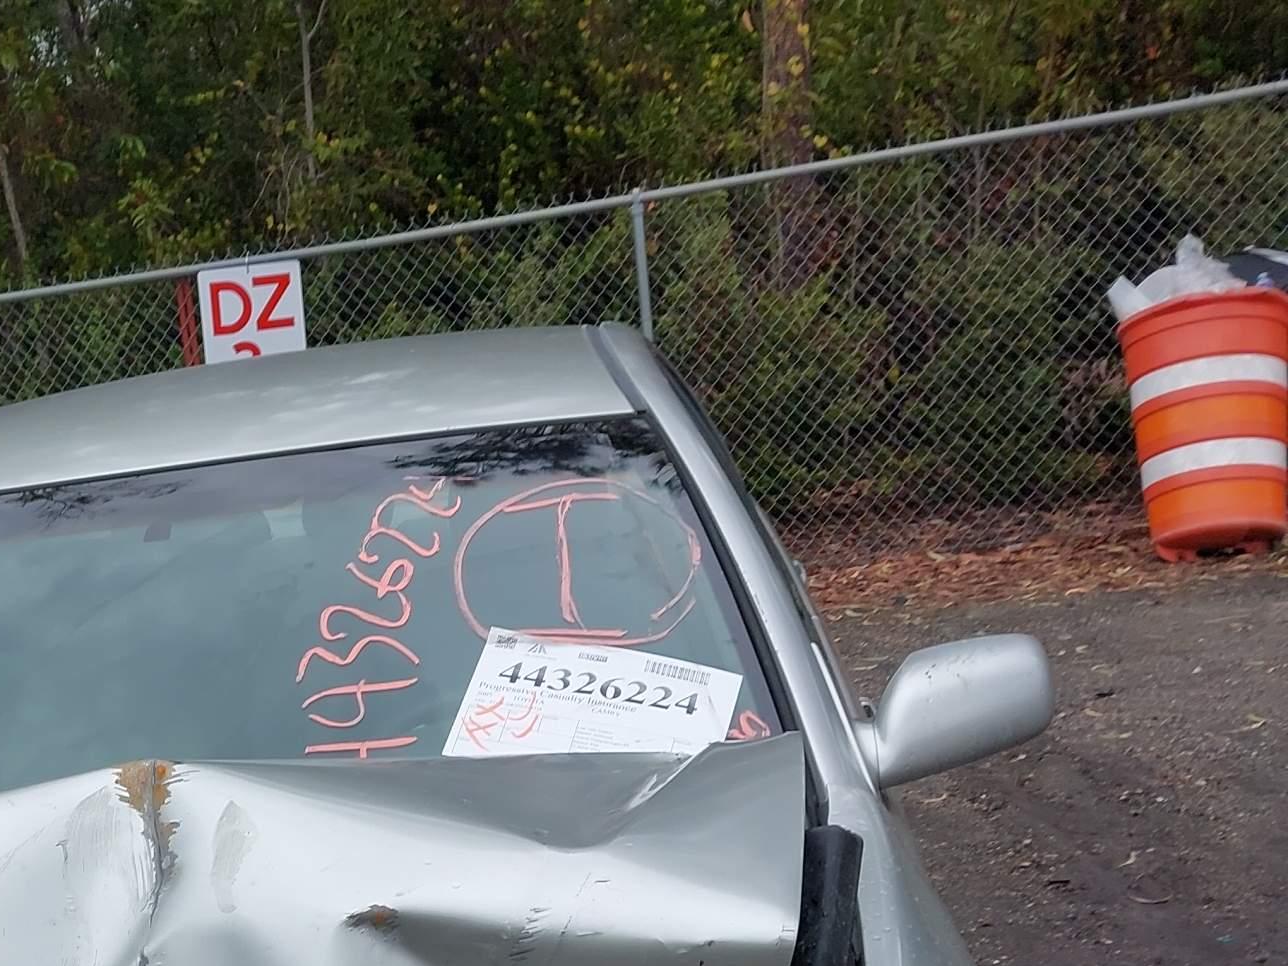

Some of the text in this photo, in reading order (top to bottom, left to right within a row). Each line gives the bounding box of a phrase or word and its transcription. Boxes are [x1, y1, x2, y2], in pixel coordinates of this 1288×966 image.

[209, 272, 295, 336] DZ
[498, 661, 698, 715] 44326224
[540, 689, 585, 705] Casualty
[586, 694, 637, 712] Insurance
